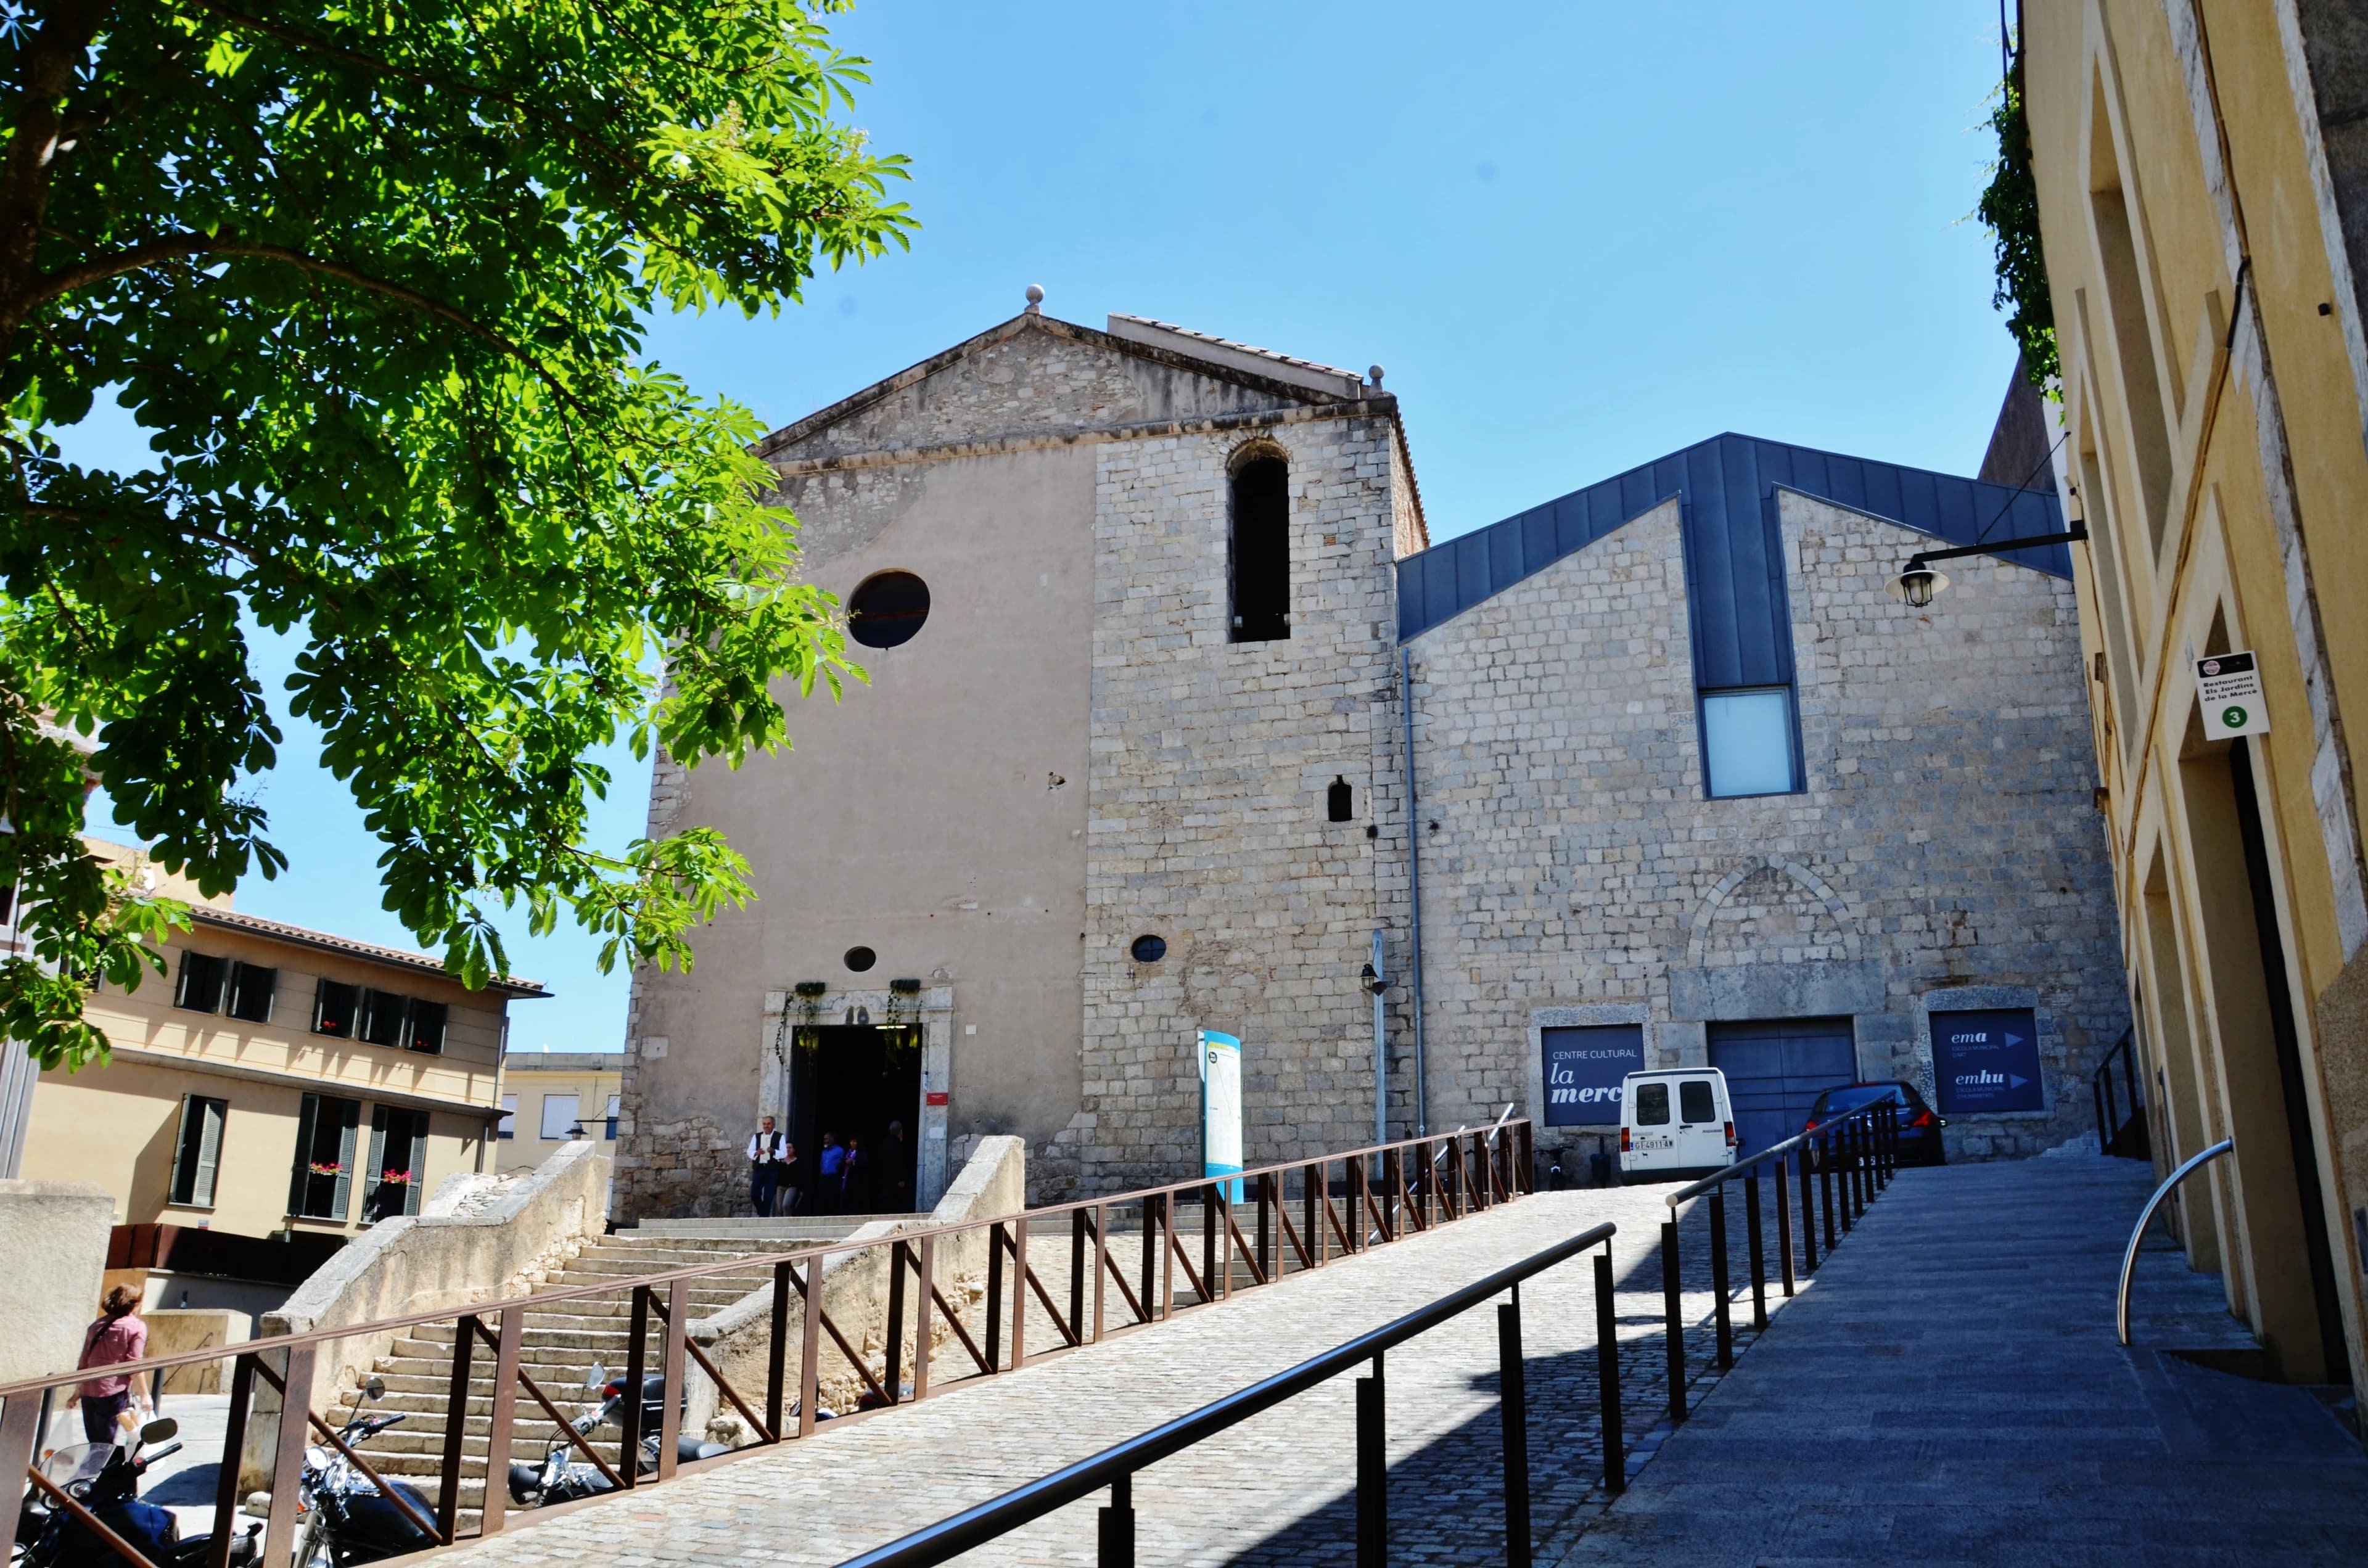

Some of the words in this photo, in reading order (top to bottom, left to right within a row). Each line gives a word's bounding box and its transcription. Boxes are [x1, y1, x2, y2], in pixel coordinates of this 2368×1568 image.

[2203, 676, 2253, 688] Restaurant
[2221, 683, 2254, 692] Jardins
[2229, 712, 2240, 723] 3
[1951, 1032, 1987, 1043] ema
[1553, 1051, 1587, 1059] CENTRE
[1590, 1049, 1637, 1059] CULTURAL
[1550, 1062, 1574, 1084] la
[1955, 1070, 2004, 1085] emhu
[1551, 1086, 1622, 1103] merc
